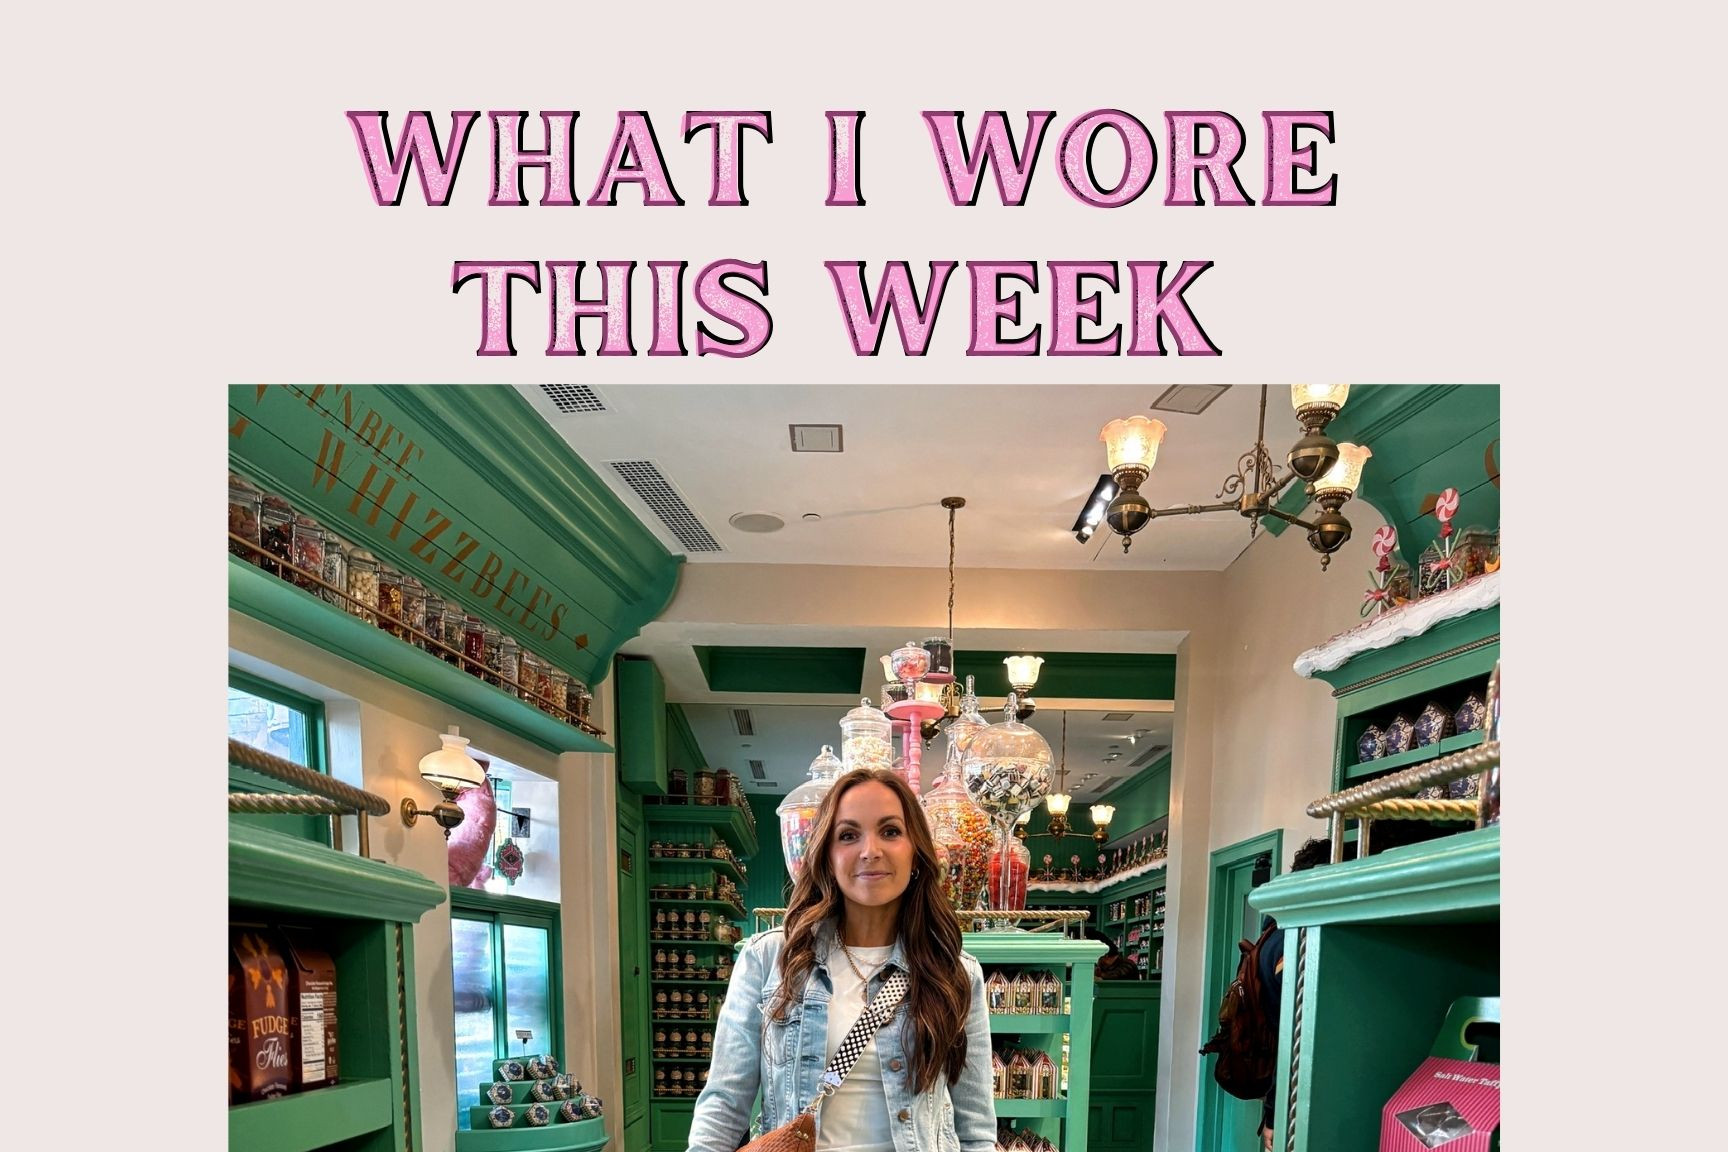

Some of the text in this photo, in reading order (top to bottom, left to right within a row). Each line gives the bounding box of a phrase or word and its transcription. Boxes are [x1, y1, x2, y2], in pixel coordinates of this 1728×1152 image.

[312, 428, 568, 642] WHIZZBEES
[252, 1015, 289, 1039] FUDGE
[256, 1037, 288, 1070] Flies
[1433, 1071, 1452, 1080] Salt
[1452, 1073, 1479, 1084] Water
